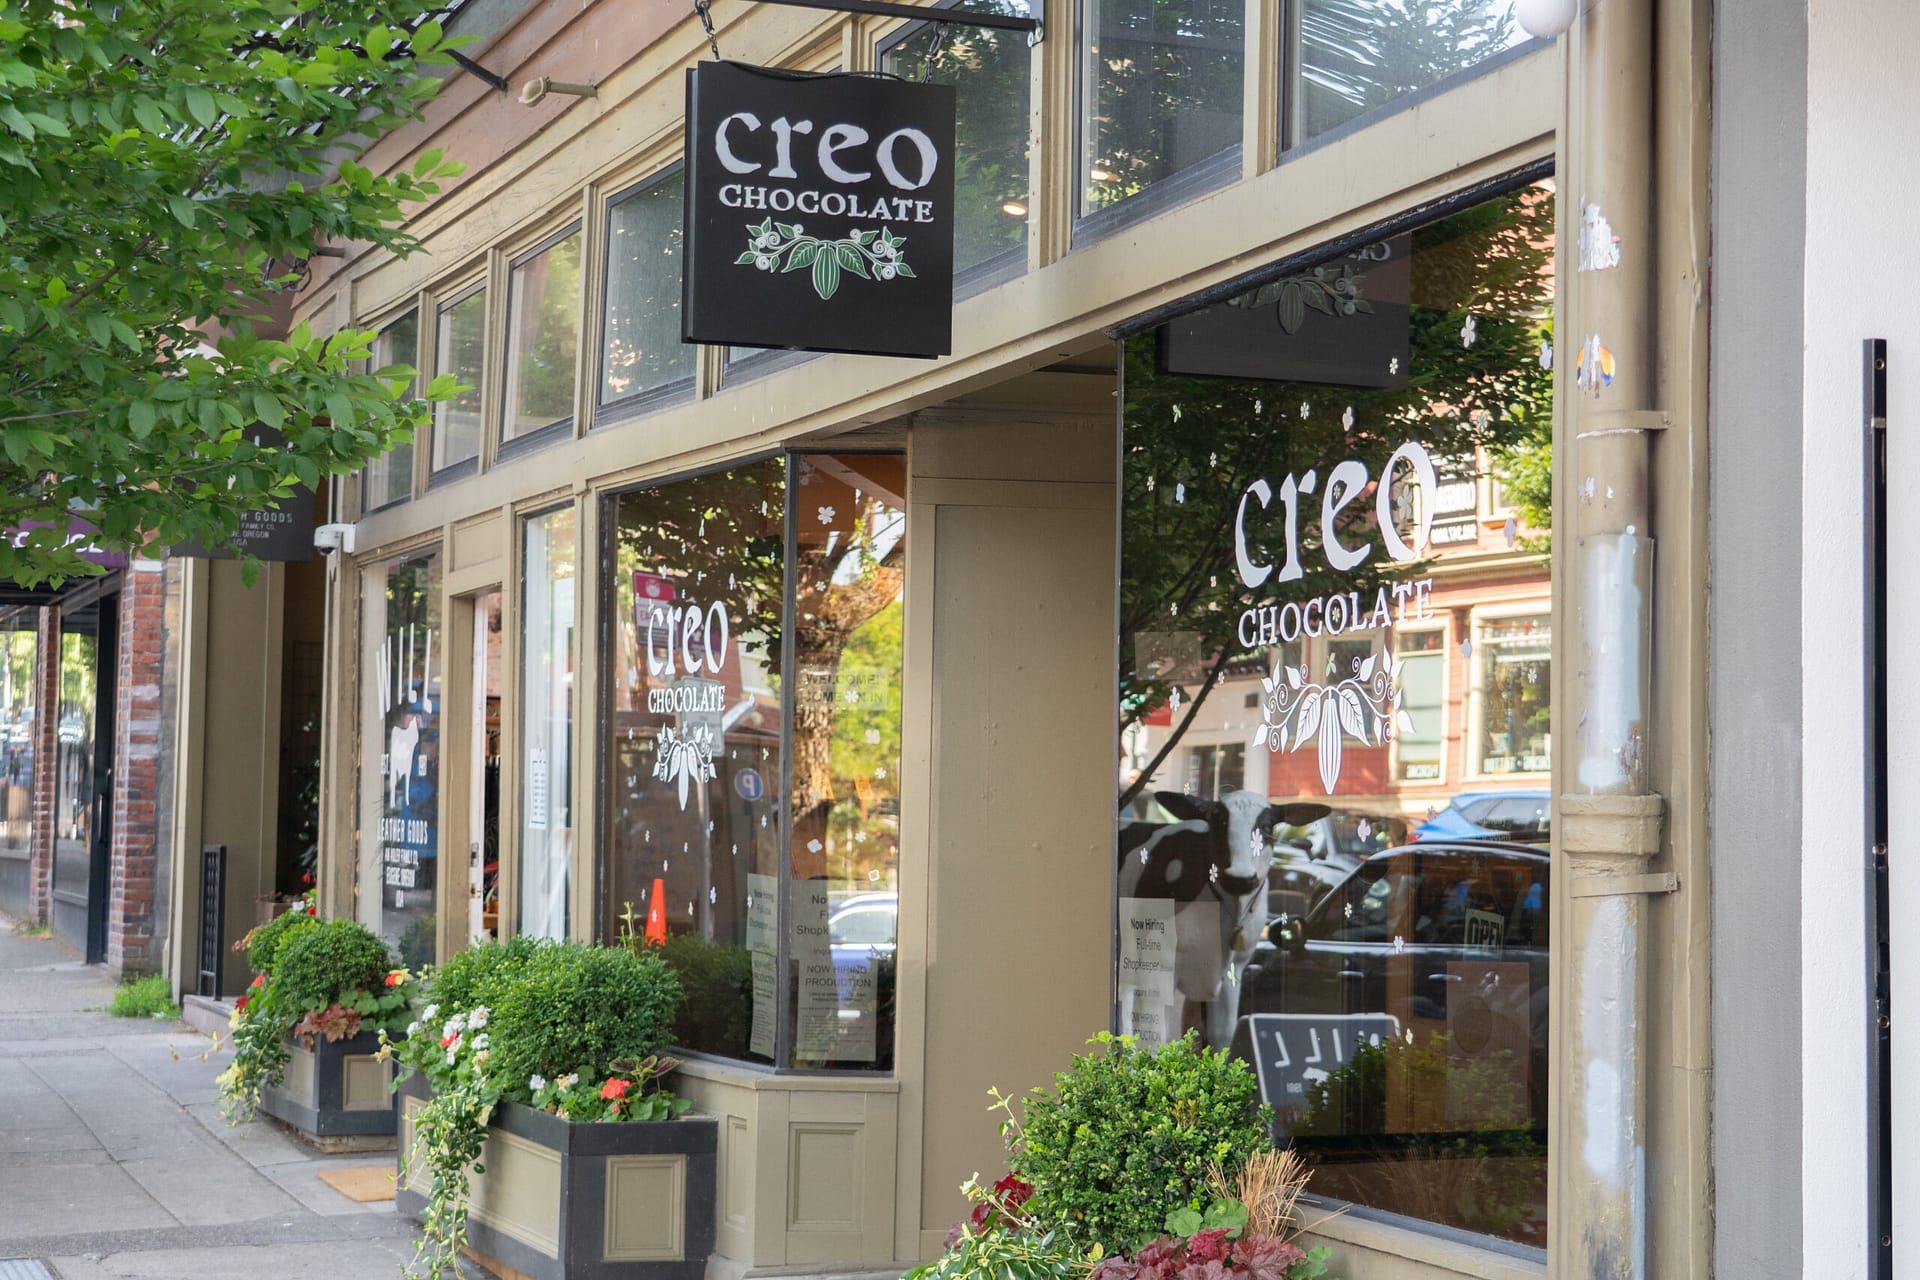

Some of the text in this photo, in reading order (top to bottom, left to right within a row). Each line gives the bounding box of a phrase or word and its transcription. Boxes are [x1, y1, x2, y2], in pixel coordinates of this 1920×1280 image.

[715, 112, 938, 190] creo
[718, 183, 935, 223] CHOCOLATE
[255, 512, 293, 524] GOODS
[1235, 441, 1437, 588] creo
[242, 530, 270, 539] OREGON
[1238, 578, 1434, 648] CHOCOLATE
[647, 600, 729, 676] creo
[376, 622, 432, 720] WILL
[647, 685, 726, 713] CHOCOLATE
[378, 815, 428, 845] LEATHER GOODS
[1130, 918, 1165, 934] Now Hiring
[806, 965, 831, 974] NOW
[1123, 957, 1159, 973] Shopkeeper
[805, 977, 871, 987] PRODUCTION
